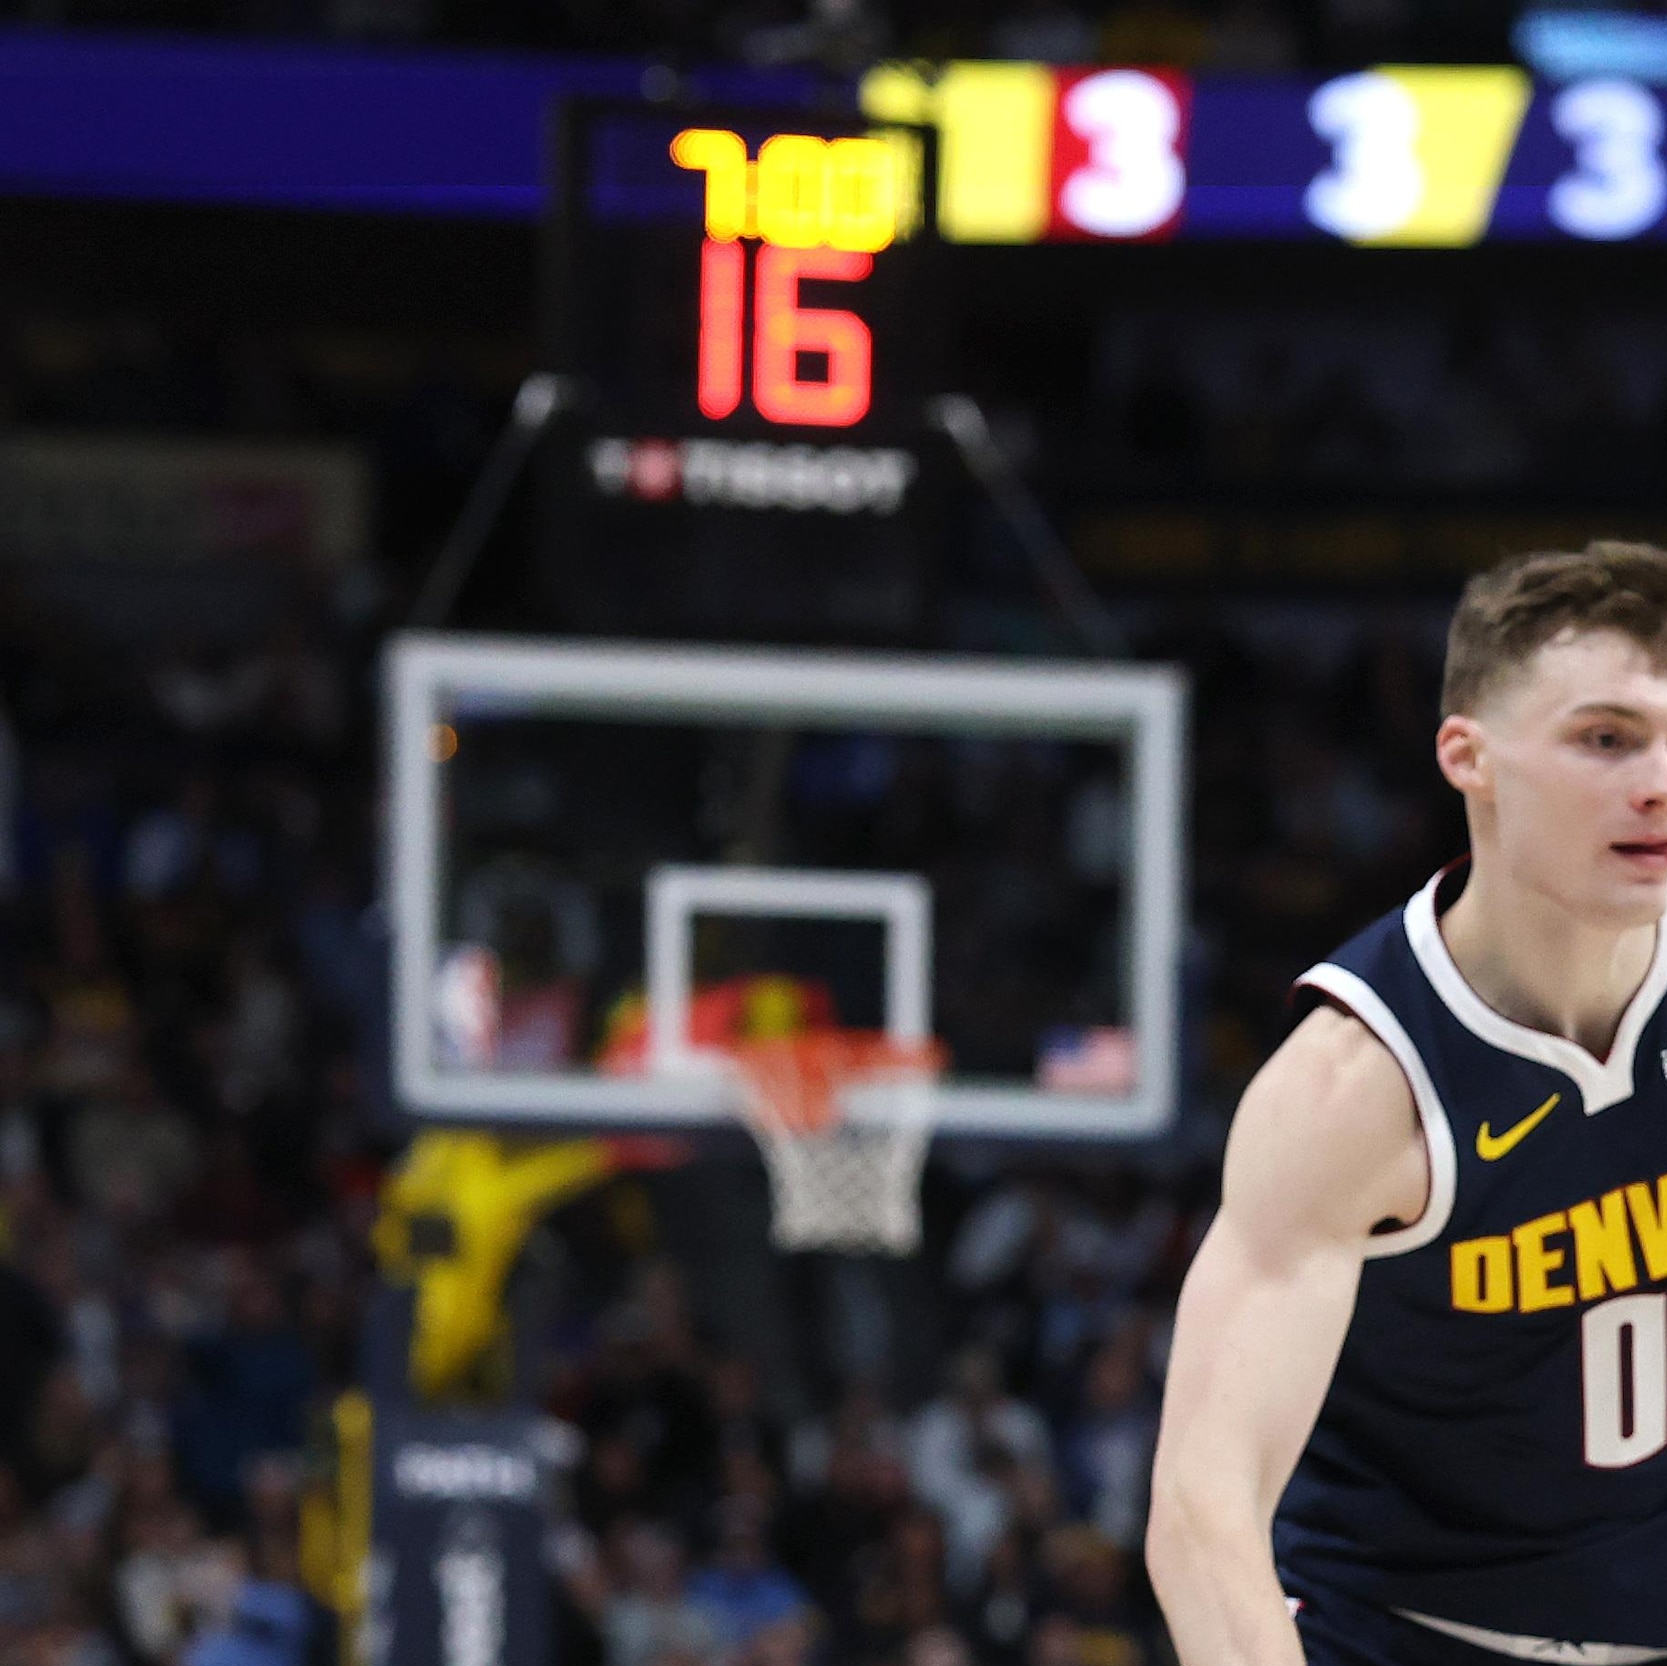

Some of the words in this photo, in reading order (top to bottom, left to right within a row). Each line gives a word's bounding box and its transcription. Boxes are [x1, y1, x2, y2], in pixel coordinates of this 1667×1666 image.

[1058, 69, 1186, 236] 3
[1304, 71, 1423, 241] 3
[698, 238, 873, 426] 16
